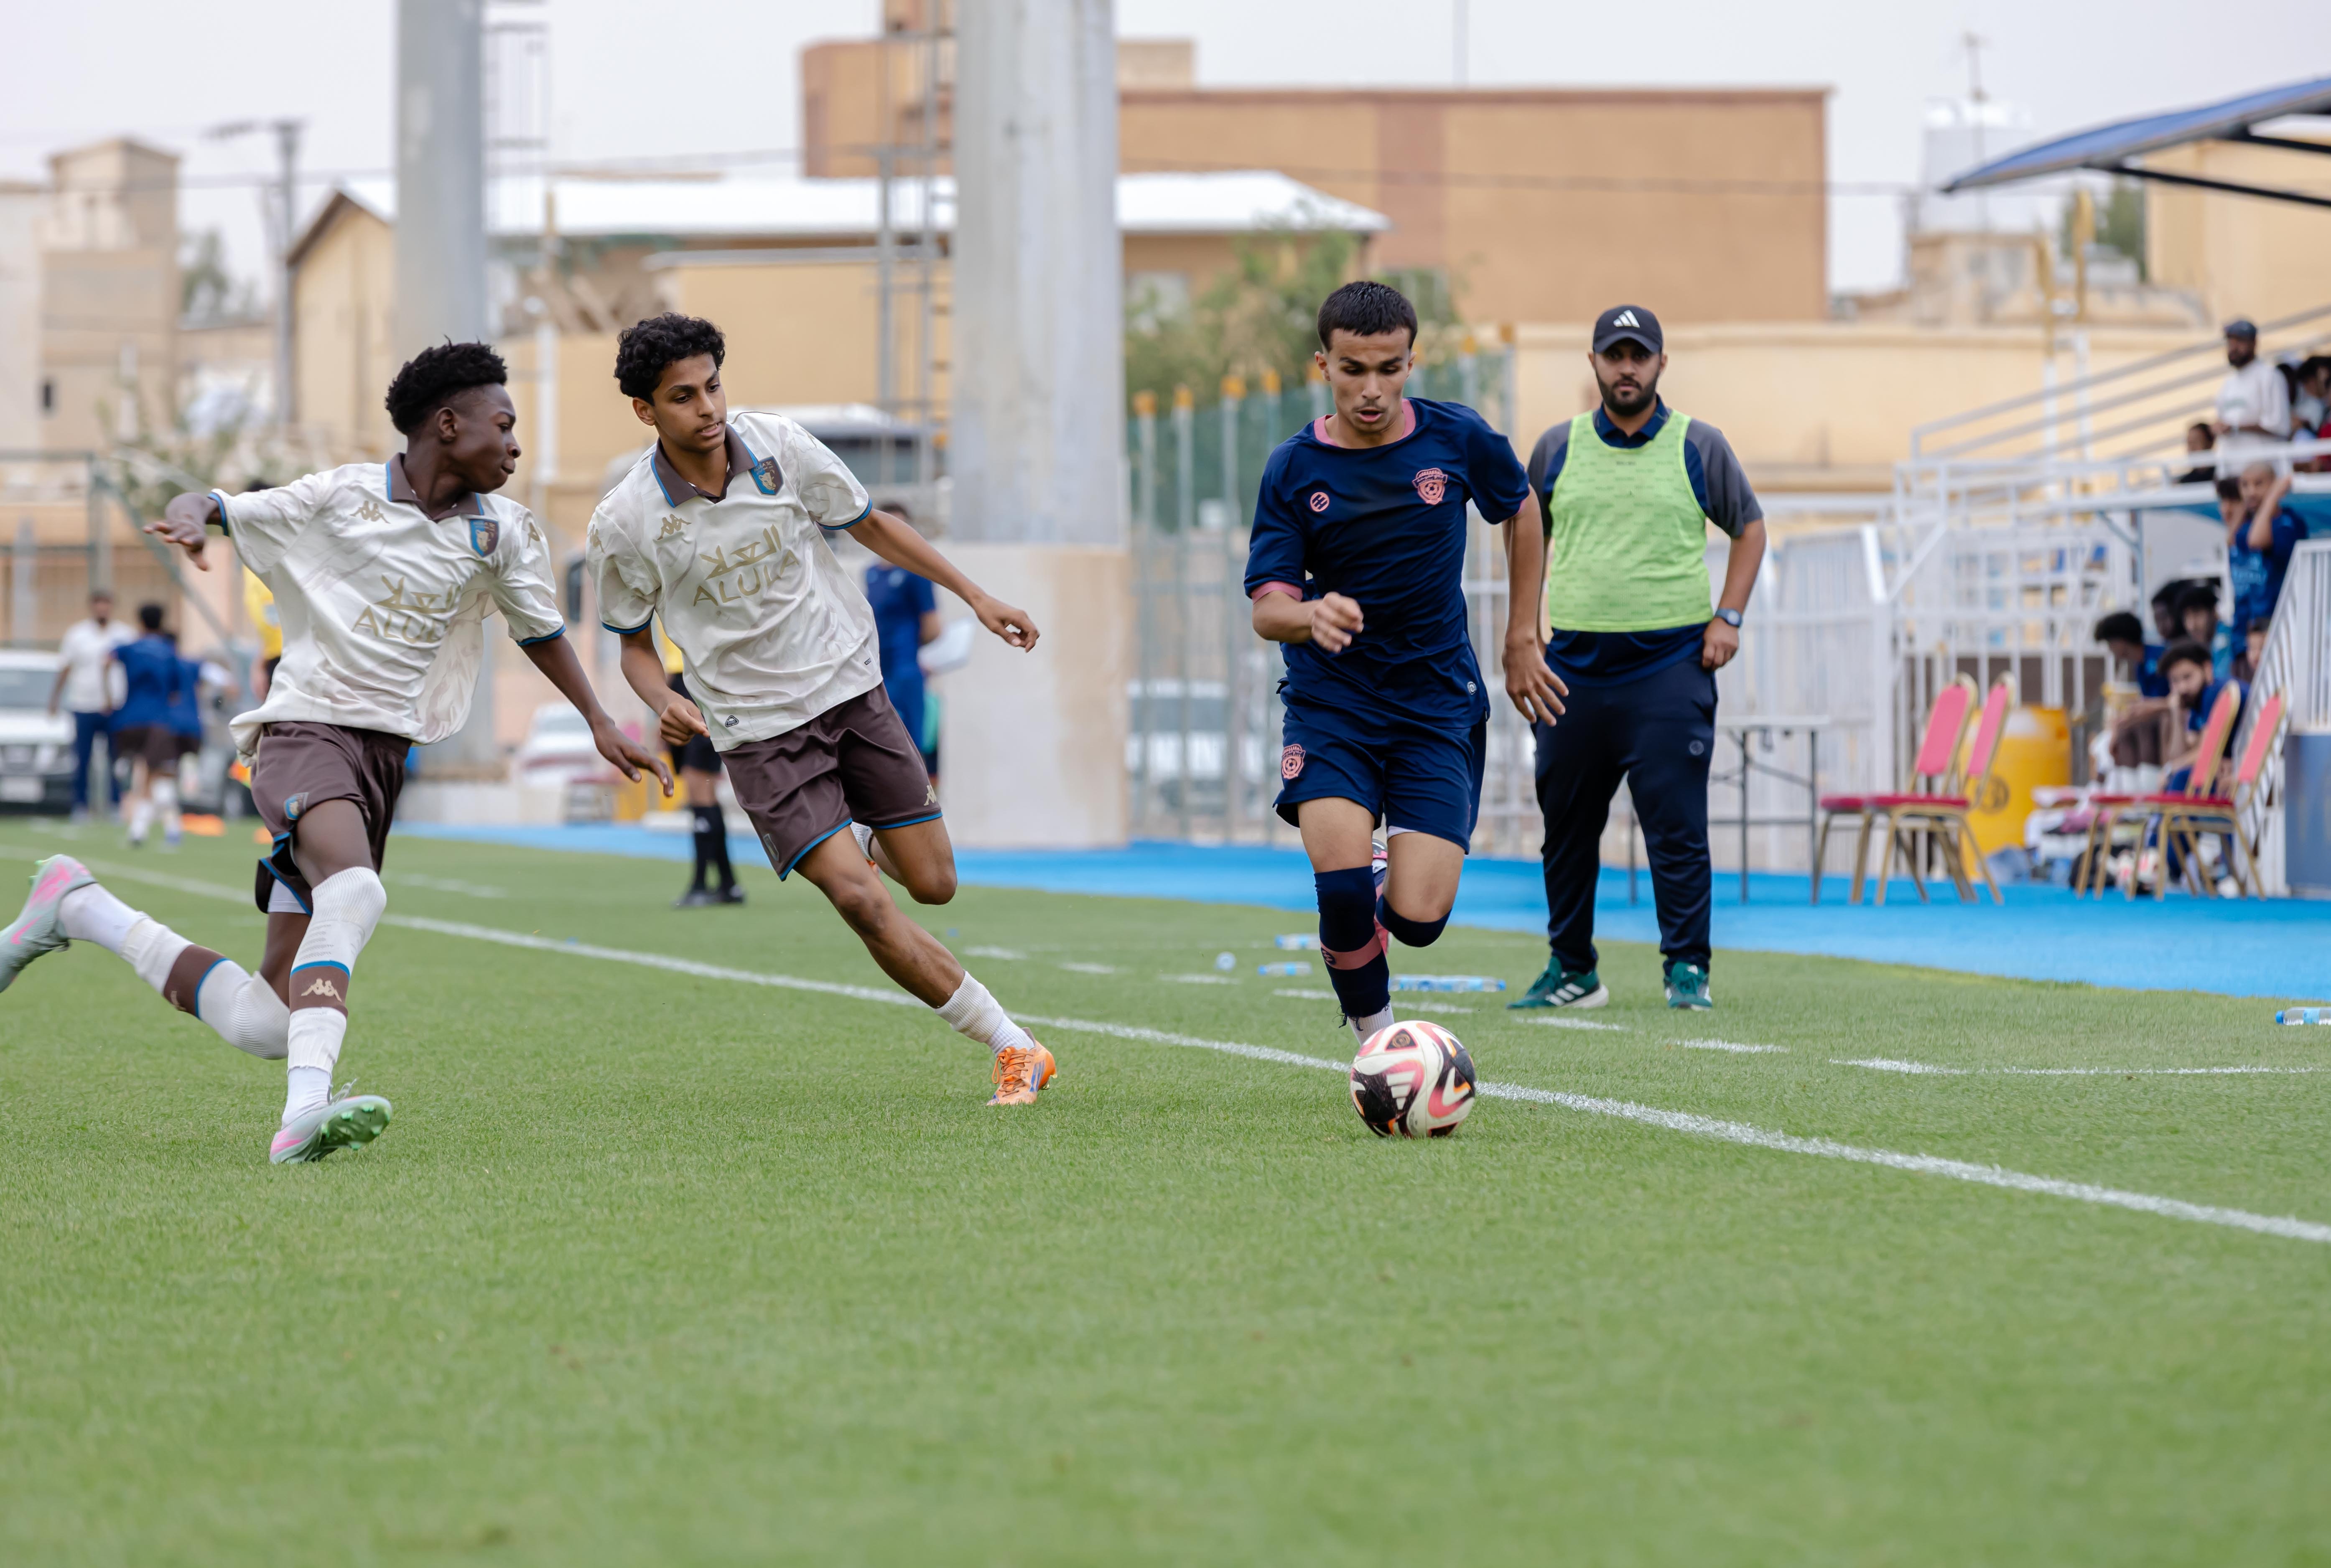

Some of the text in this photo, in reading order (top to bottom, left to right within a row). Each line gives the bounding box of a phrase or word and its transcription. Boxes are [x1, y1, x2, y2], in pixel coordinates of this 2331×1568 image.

[693, 550, 800, 607] ALULA
[699, 524, 782, 580] العلا
[352, 605, 443, 644] ALUL
